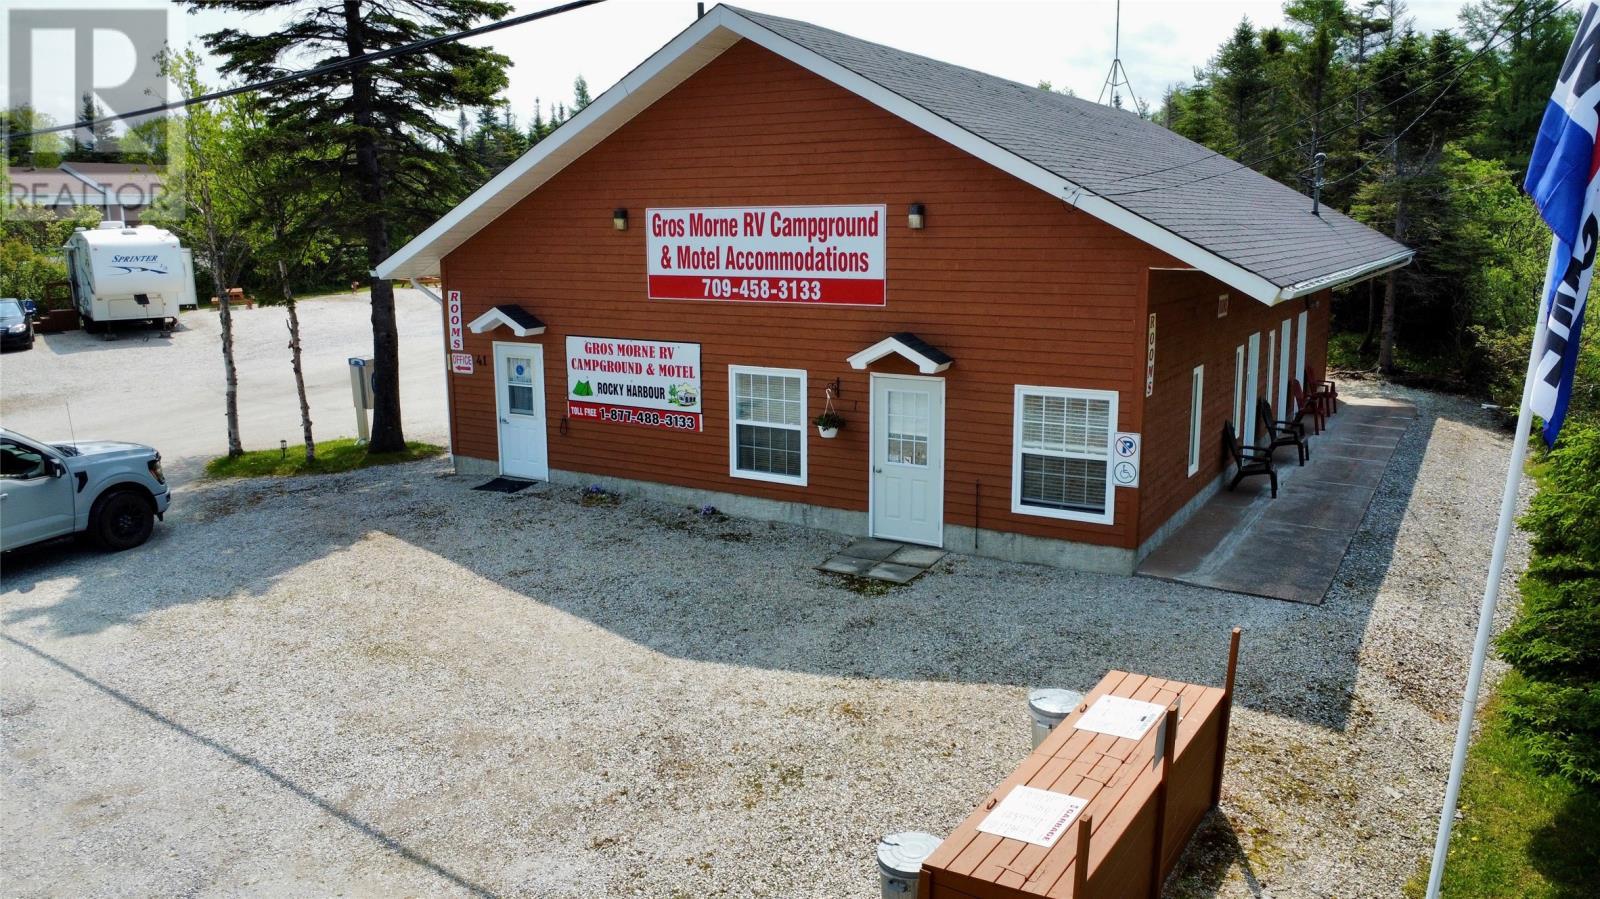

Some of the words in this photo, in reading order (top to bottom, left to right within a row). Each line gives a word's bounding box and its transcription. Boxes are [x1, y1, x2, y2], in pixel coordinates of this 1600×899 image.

[652, 213, 685, 237] Gros
[689, 212, 738, 237] Morne
[743, 212, 765, 237] RV
[770, 210, 879, 243] Campground
[660, 245, 672, 269] &
[677, 245, 720, 270] Motel
[725, 245, 869, 273] Accommodations
[702, 278, 821, 300] 709-458-3133
[450, 292, 461, 349] ROOMS
[452, 355, 472, 366] OFFICE
[476, 355, 487, 366] 41
[584, 341, 614, 356] GROS
[617, 343, 656, 359] MORNE
[659, 346, 675, 360] RV
[571, 358, 642, 375] CAMPGROUND
[646, 363, 655, 376] &
[659, 364, 696, 379] MOTEL
[597, 382, 624, 396] ROCKY
[626, 384, 665, 400] HARBOUR
[570, 406, 583, 416] TOLL
[584, 407, 597, 417] FREE
[599, 407, 695, 429] 1-877-488-3133
